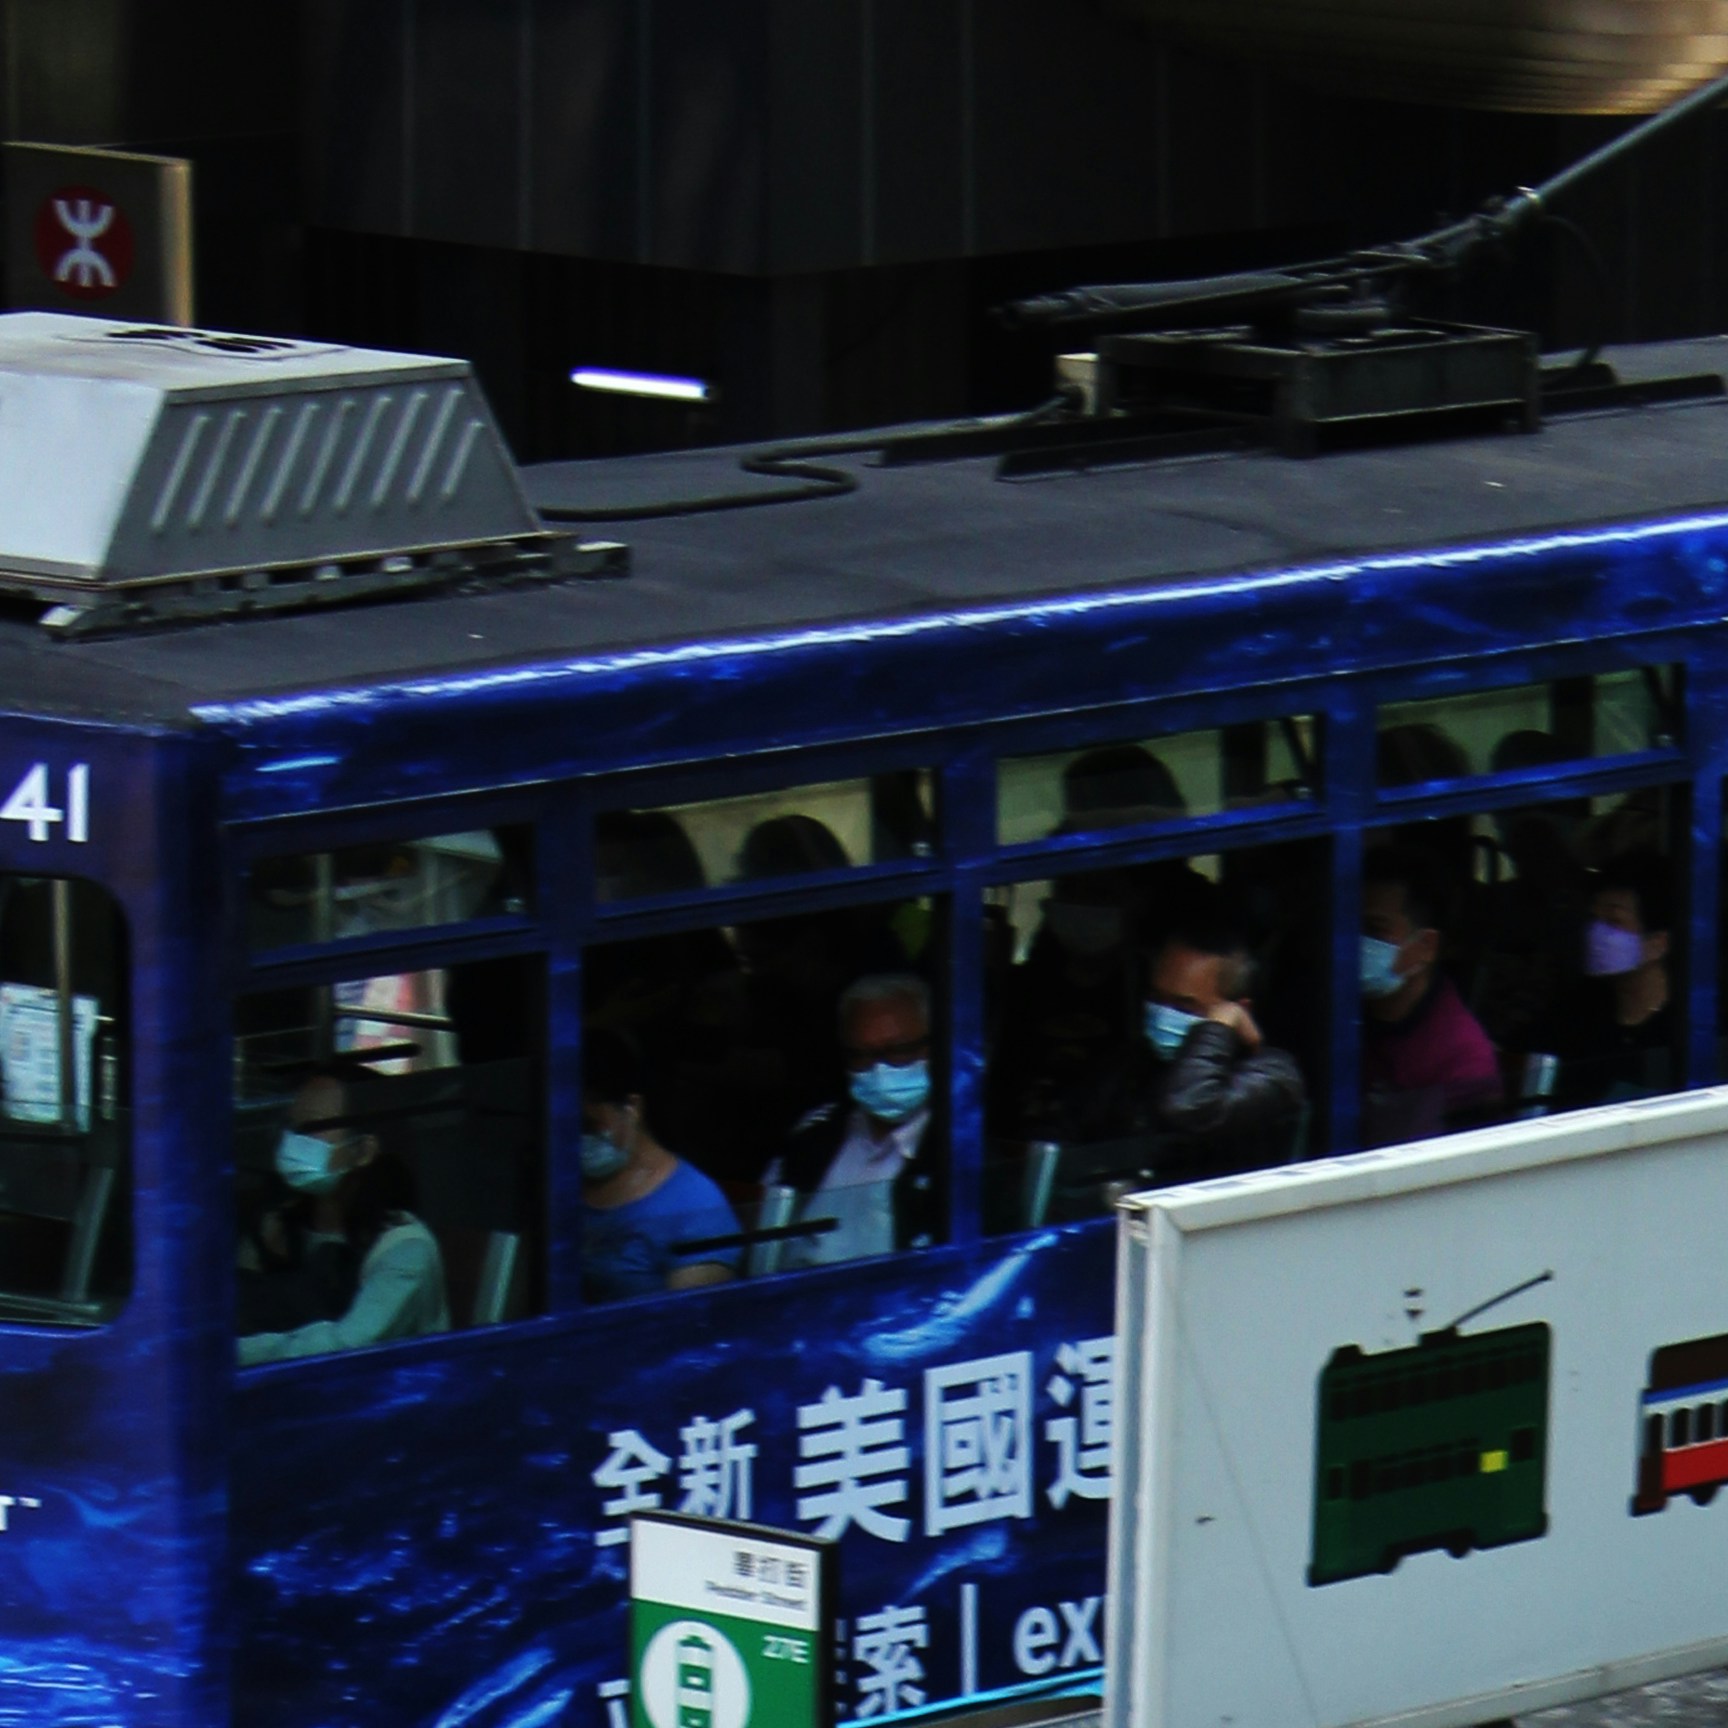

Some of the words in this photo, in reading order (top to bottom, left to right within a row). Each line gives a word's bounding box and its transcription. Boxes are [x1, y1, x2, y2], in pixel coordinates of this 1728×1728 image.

[0, 762, 90, 843] 41
[591, 1408, 760, 1547] 全新
[793, 1336, 1116, 1544] 美國運
[834, 1605, 930, 1719] 索
